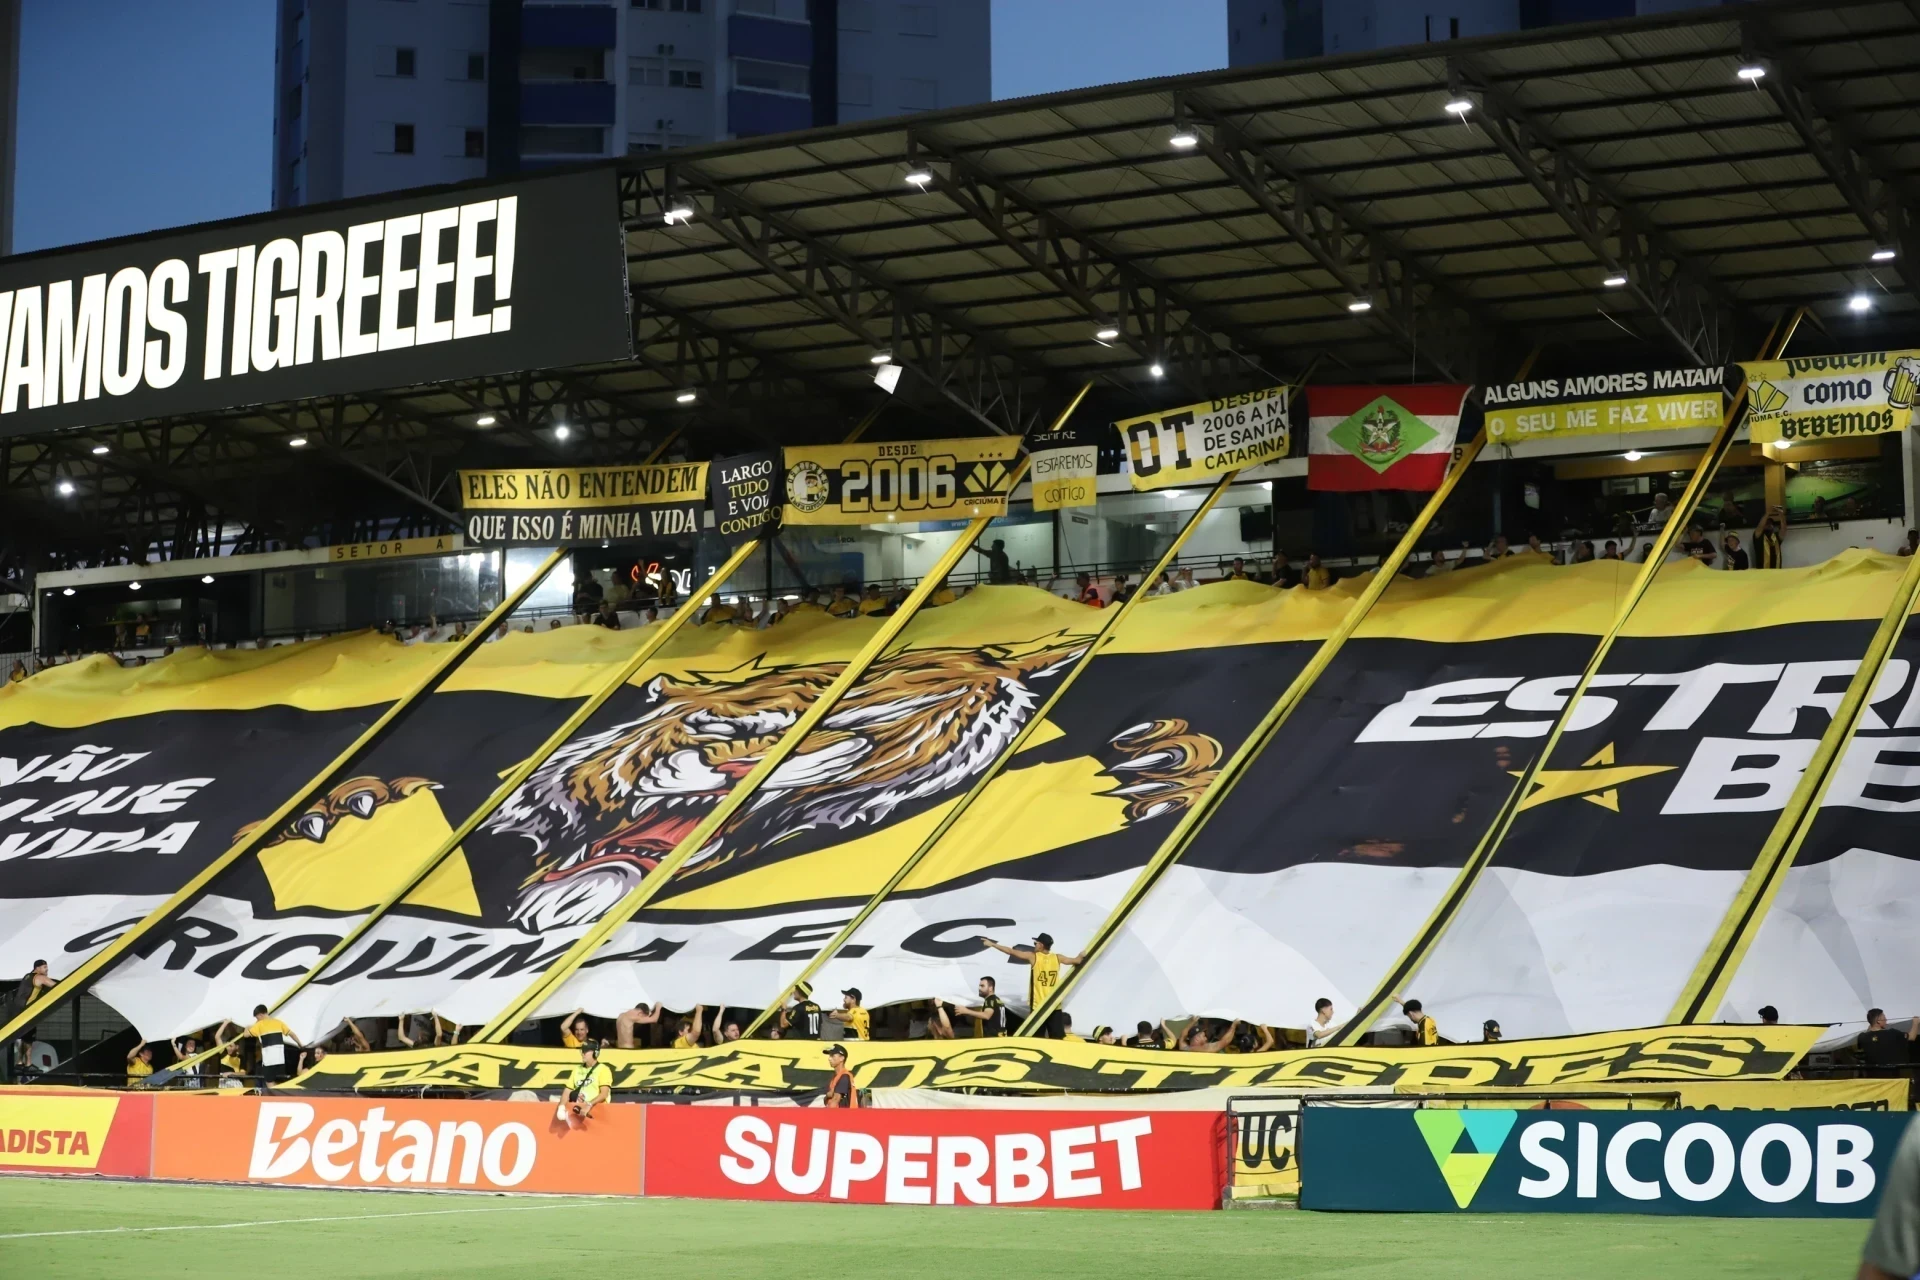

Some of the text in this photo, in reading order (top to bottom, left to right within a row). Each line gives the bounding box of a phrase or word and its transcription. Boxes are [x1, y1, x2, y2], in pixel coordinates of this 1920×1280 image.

[198, 195, 518, 381] TIGREEEE!
[1484, 366, 1724, 405] ALGUNS AMORES MATAM
[1203, 411, 1246, 433] 2006
[1251, 407, 1263, 422] A
[1204, 417, 1286, 451] DE SANTA
[1490, 399, 1718, 435] O SEU ME FAZ VIVER
[878, 445, 917, 457] DESDE
[1036, 453, 1094, 474] ESTAREMOS
[1205, 435, 1285, 470] CATARINA
[469, 466, 699, 500] ELES NÃO ENTENDEM
[721, 460, 772, 484] LARGO
[729, 479, 769, 498] TUDO
[840, 454, 956, 513] 2006
[469, 508, 698, 541] QUE ISSO É MINHA VIDA
[720, 506, 782, 535] CONTIGO
[728, 501, 738, 516] E
[336, 538, 444, 559] SETOR A
[20, 777, 216, 823] QUE
[0, 820, 200, 862] VIDA
[1037, 970, 1058, 987] 47
[807, 1012, 819, 1035] 10
[249, 1102, 537, 1187] Betano
[719, 1115, 1153, 1205] SUPERBET
[1517, 1120, 1876, 1204] SICOOB
